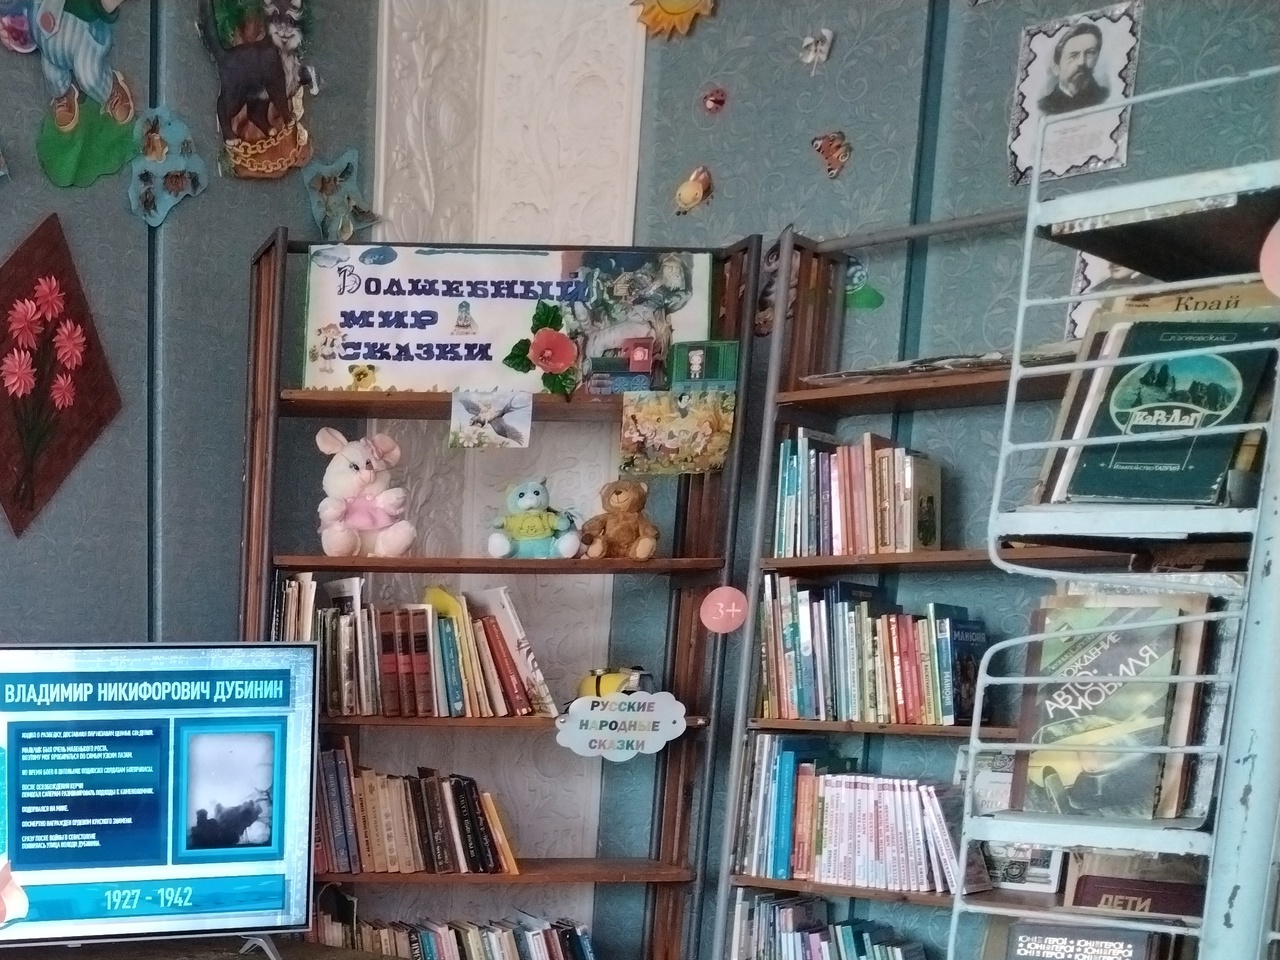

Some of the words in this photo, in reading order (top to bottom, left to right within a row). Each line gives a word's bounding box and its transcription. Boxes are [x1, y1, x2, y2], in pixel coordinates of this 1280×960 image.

[340, 310, 439, 329] МИР
[338, 342, 492, 361] СКАЗКИ
[712, 602, 741, 620] 3+
[5, 684, 93, 706] ВЛАДИМИР
[98, 681, 210, 704] НИКИФОРОВИЧ
[214, 679, 284, 702] ДУБИНИН
[590, 700, 655, 713] РУССКИЕ
[579, 719, 660, 733] НАРОДНЫЕ
[588, 739, 645, 751] СКАЗКИ
[105, 889, 141, 910] 1927
[158, 887, 192, 908] 1942
[1098, 894, 1151, 912] ДЕТИ
